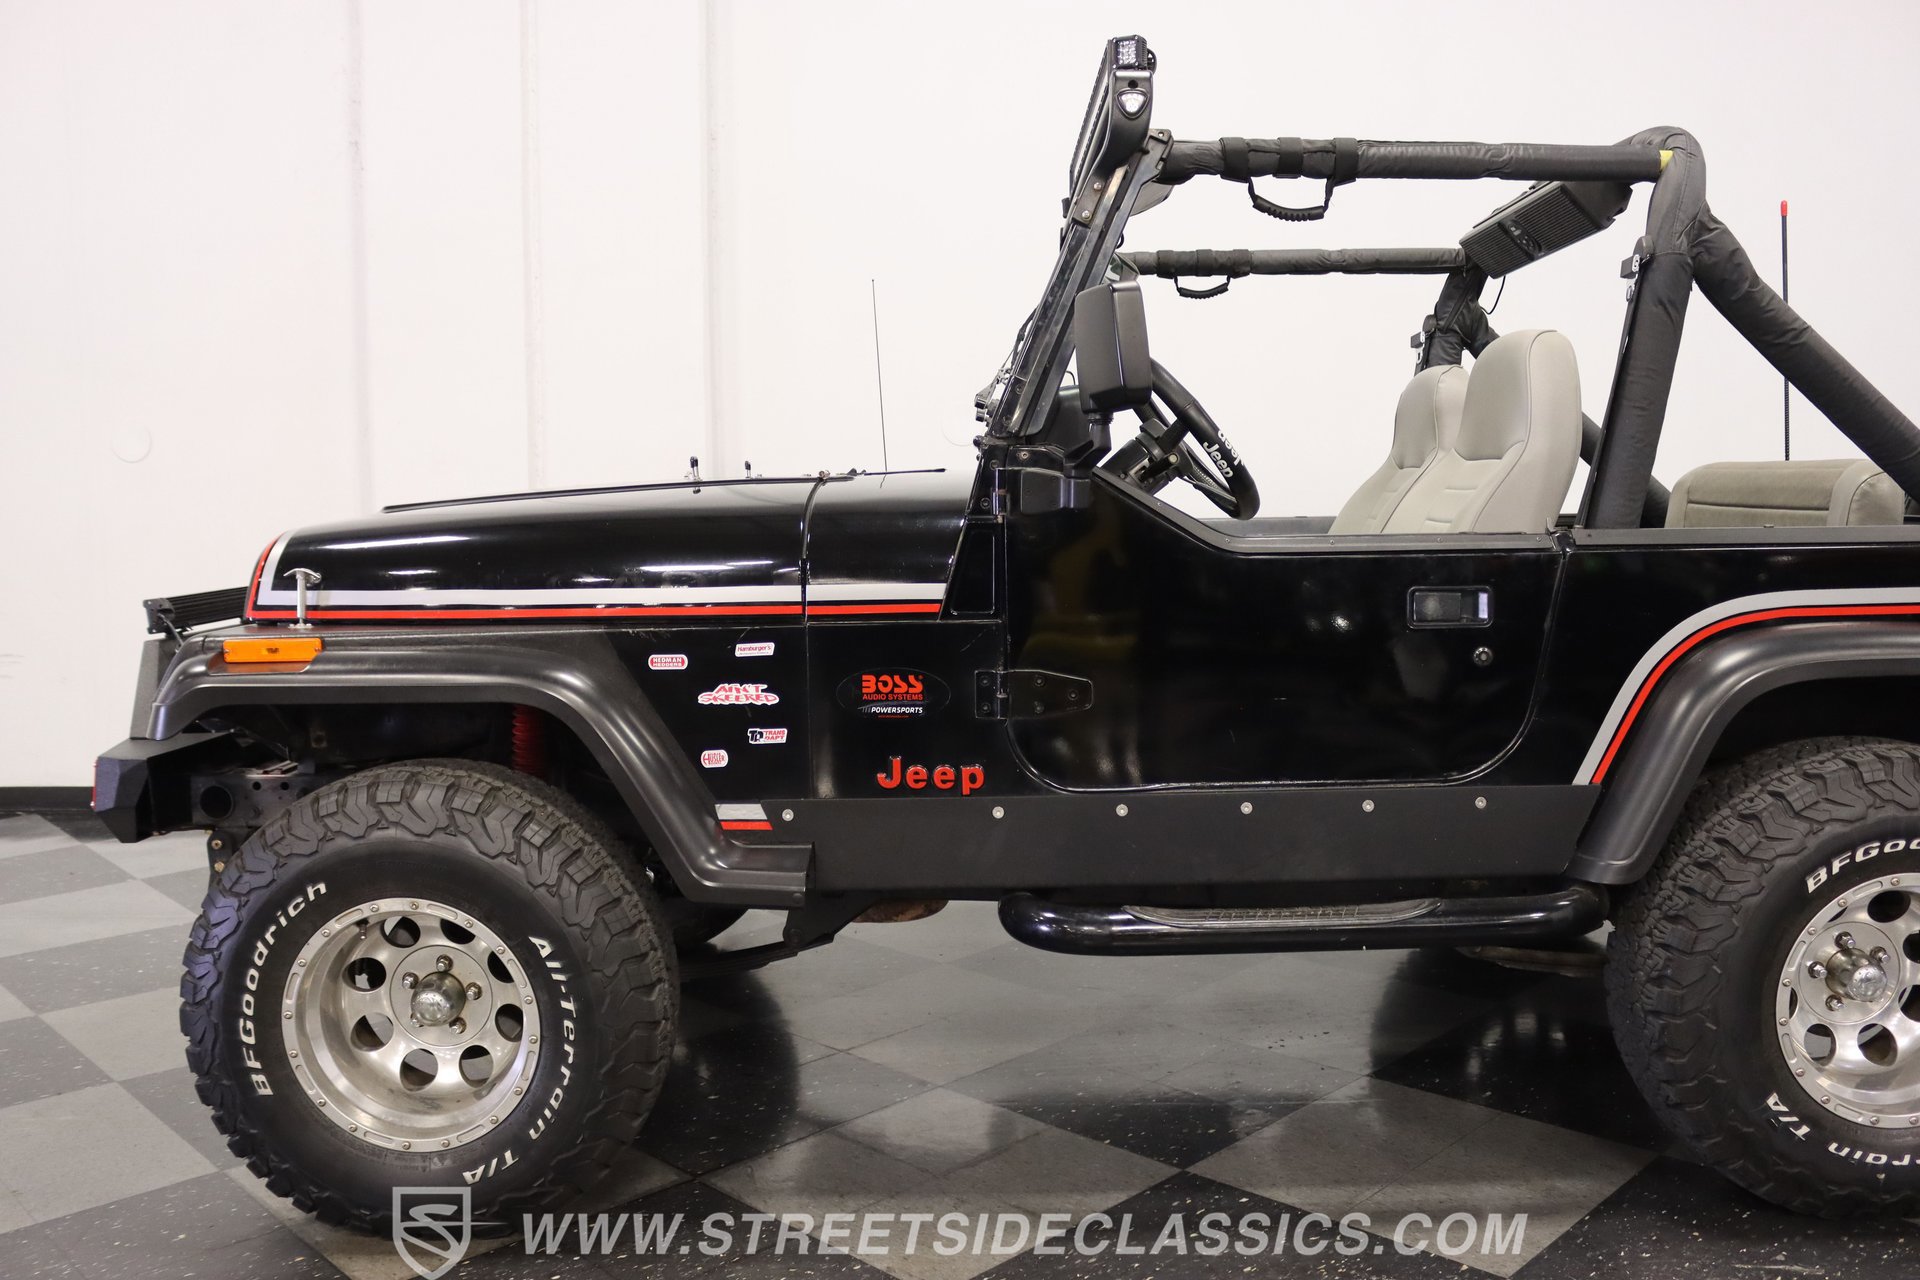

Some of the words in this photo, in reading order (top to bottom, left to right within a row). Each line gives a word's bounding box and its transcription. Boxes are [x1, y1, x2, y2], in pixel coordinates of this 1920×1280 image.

[1202, 441, 1234, 478] Jeep
[699, 693, 778, 703] SKEERED
[861, 674, 923, 694] BOSS
[862, 693, 887, 701] AUDIO
[887, 693, 923, 701] SYSTEMS
[871, 706, 923, 714] POWERSPORTS
[876, 755, 986, 796] Jeep
[238, 881, 328, 1097] BFGoodrich
[527, 935, 578, 1142] All-Terrain
[1765, 1091, 1811, 1141] T/A
[461, 1148, 520, 1186] T/A
[1827, 1141, 1920, 1167] rain
